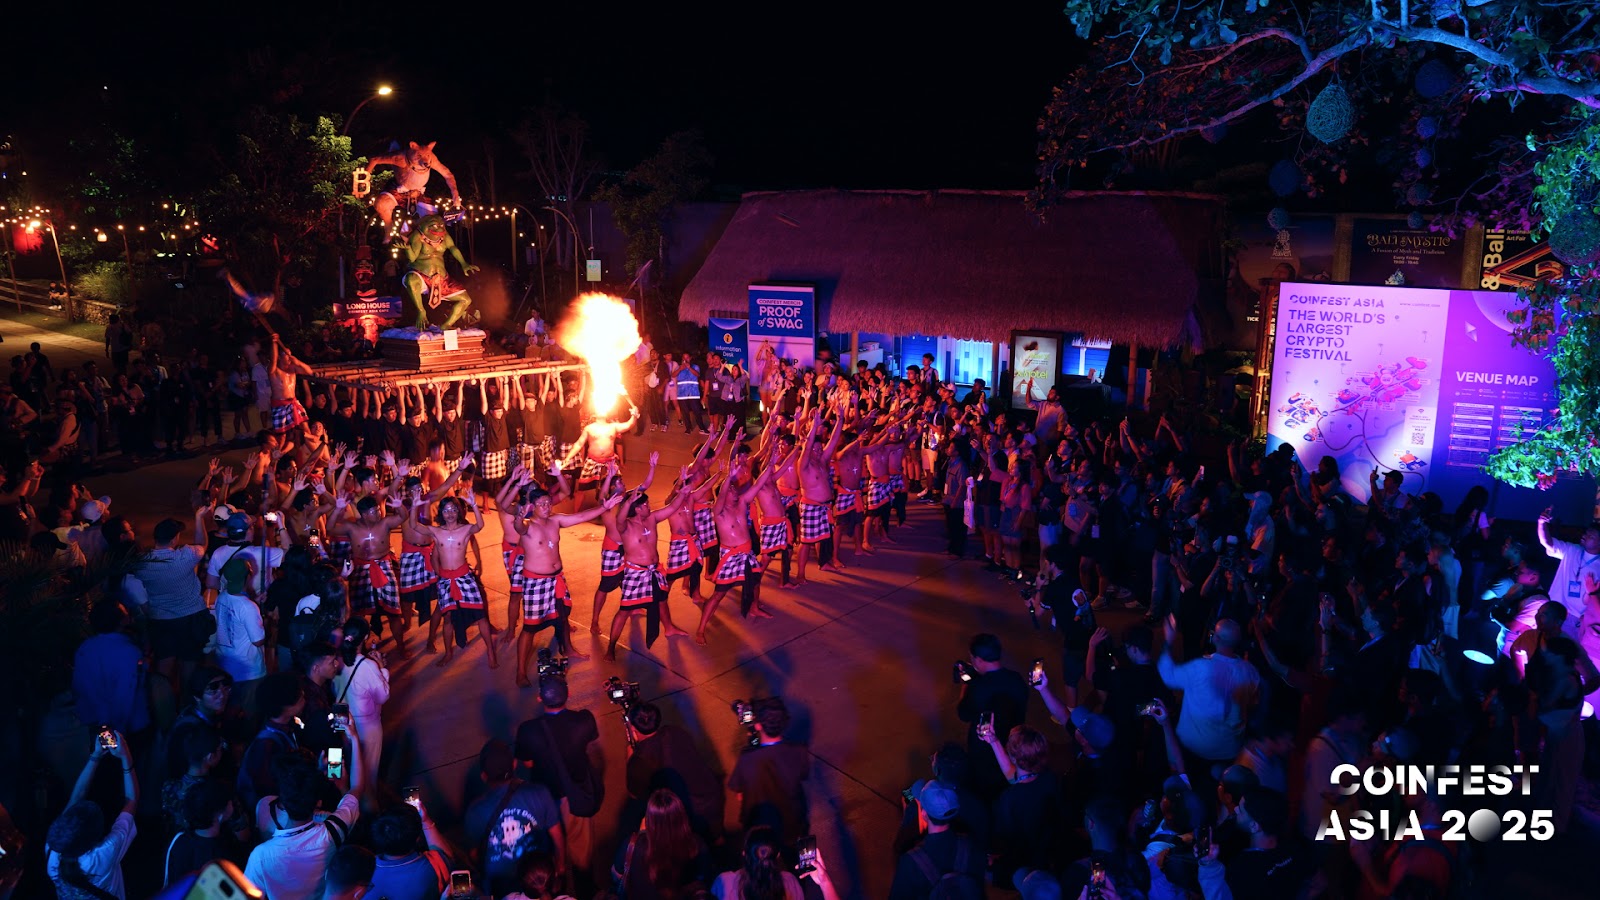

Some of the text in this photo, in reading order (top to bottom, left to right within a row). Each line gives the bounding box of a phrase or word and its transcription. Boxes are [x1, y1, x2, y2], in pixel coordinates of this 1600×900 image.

[1367, 233, 1451, 248] BALI MYSTIC
[1483, 228, 1505, 267] Bali
[1289, 294, 1385, 308] COINFEST ASIA
[759, 306, 801, 317] PROOF
[1288, 309, 1386, 324] THE WORLD'S
[758, 317, 803, 329] of SWAG
[1287, 322, 1353, 336] LARGEST
[1286, 335, 1344, 348] CRYPTO
[1285, 348, 1352, 361] FESTIVAL
[1455, 371, 1539, 387] VENUE MAP
